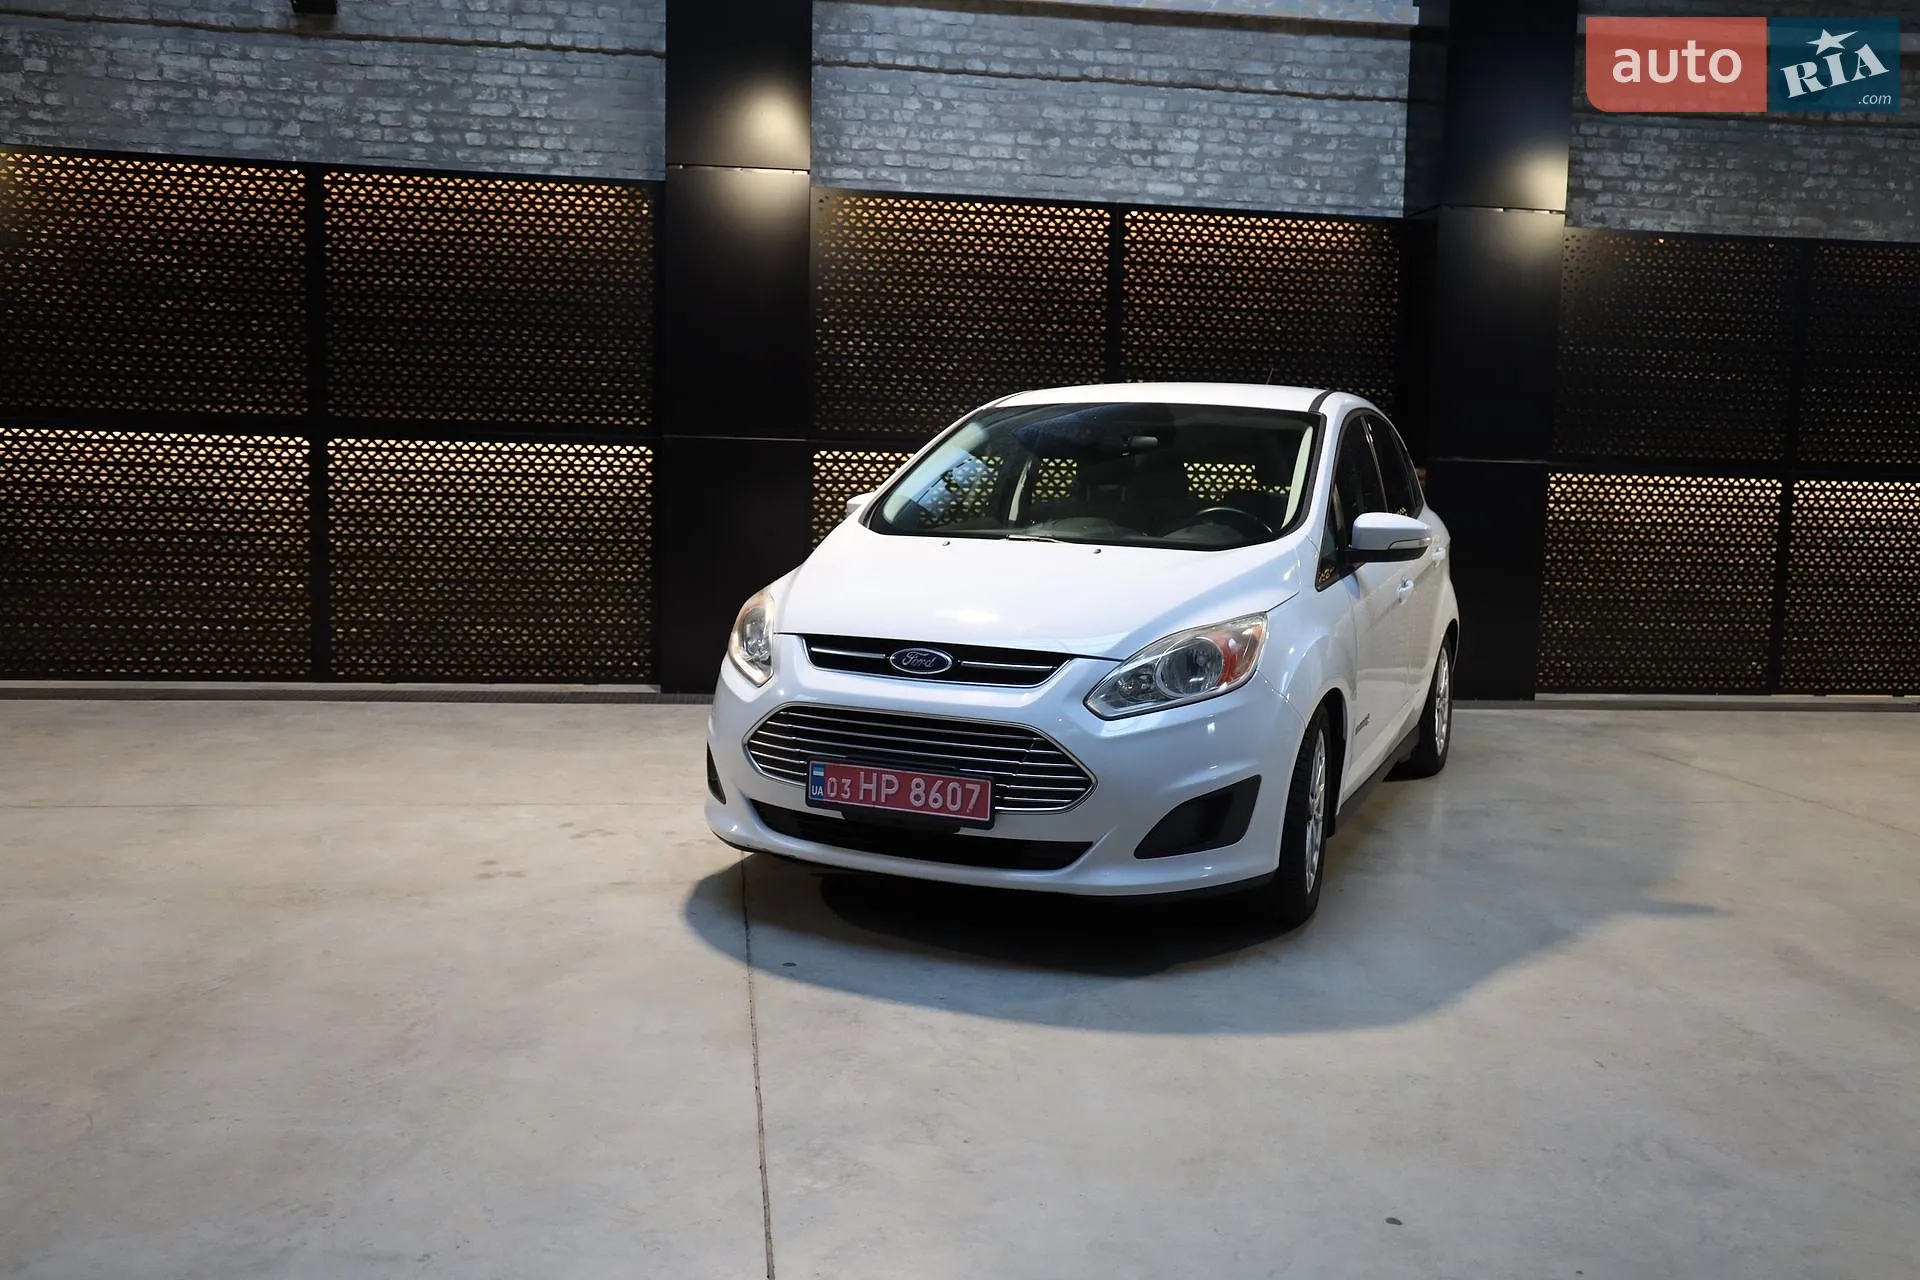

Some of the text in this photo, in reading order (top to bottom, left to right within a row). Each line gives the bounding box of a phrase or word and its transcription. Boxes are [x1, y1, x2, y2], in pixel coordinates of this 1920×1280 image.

[902, 651, 937, 668] Ford
[811, 785, 824, 797] UA
[827, 771, 981, 813] 03 HP 8607
